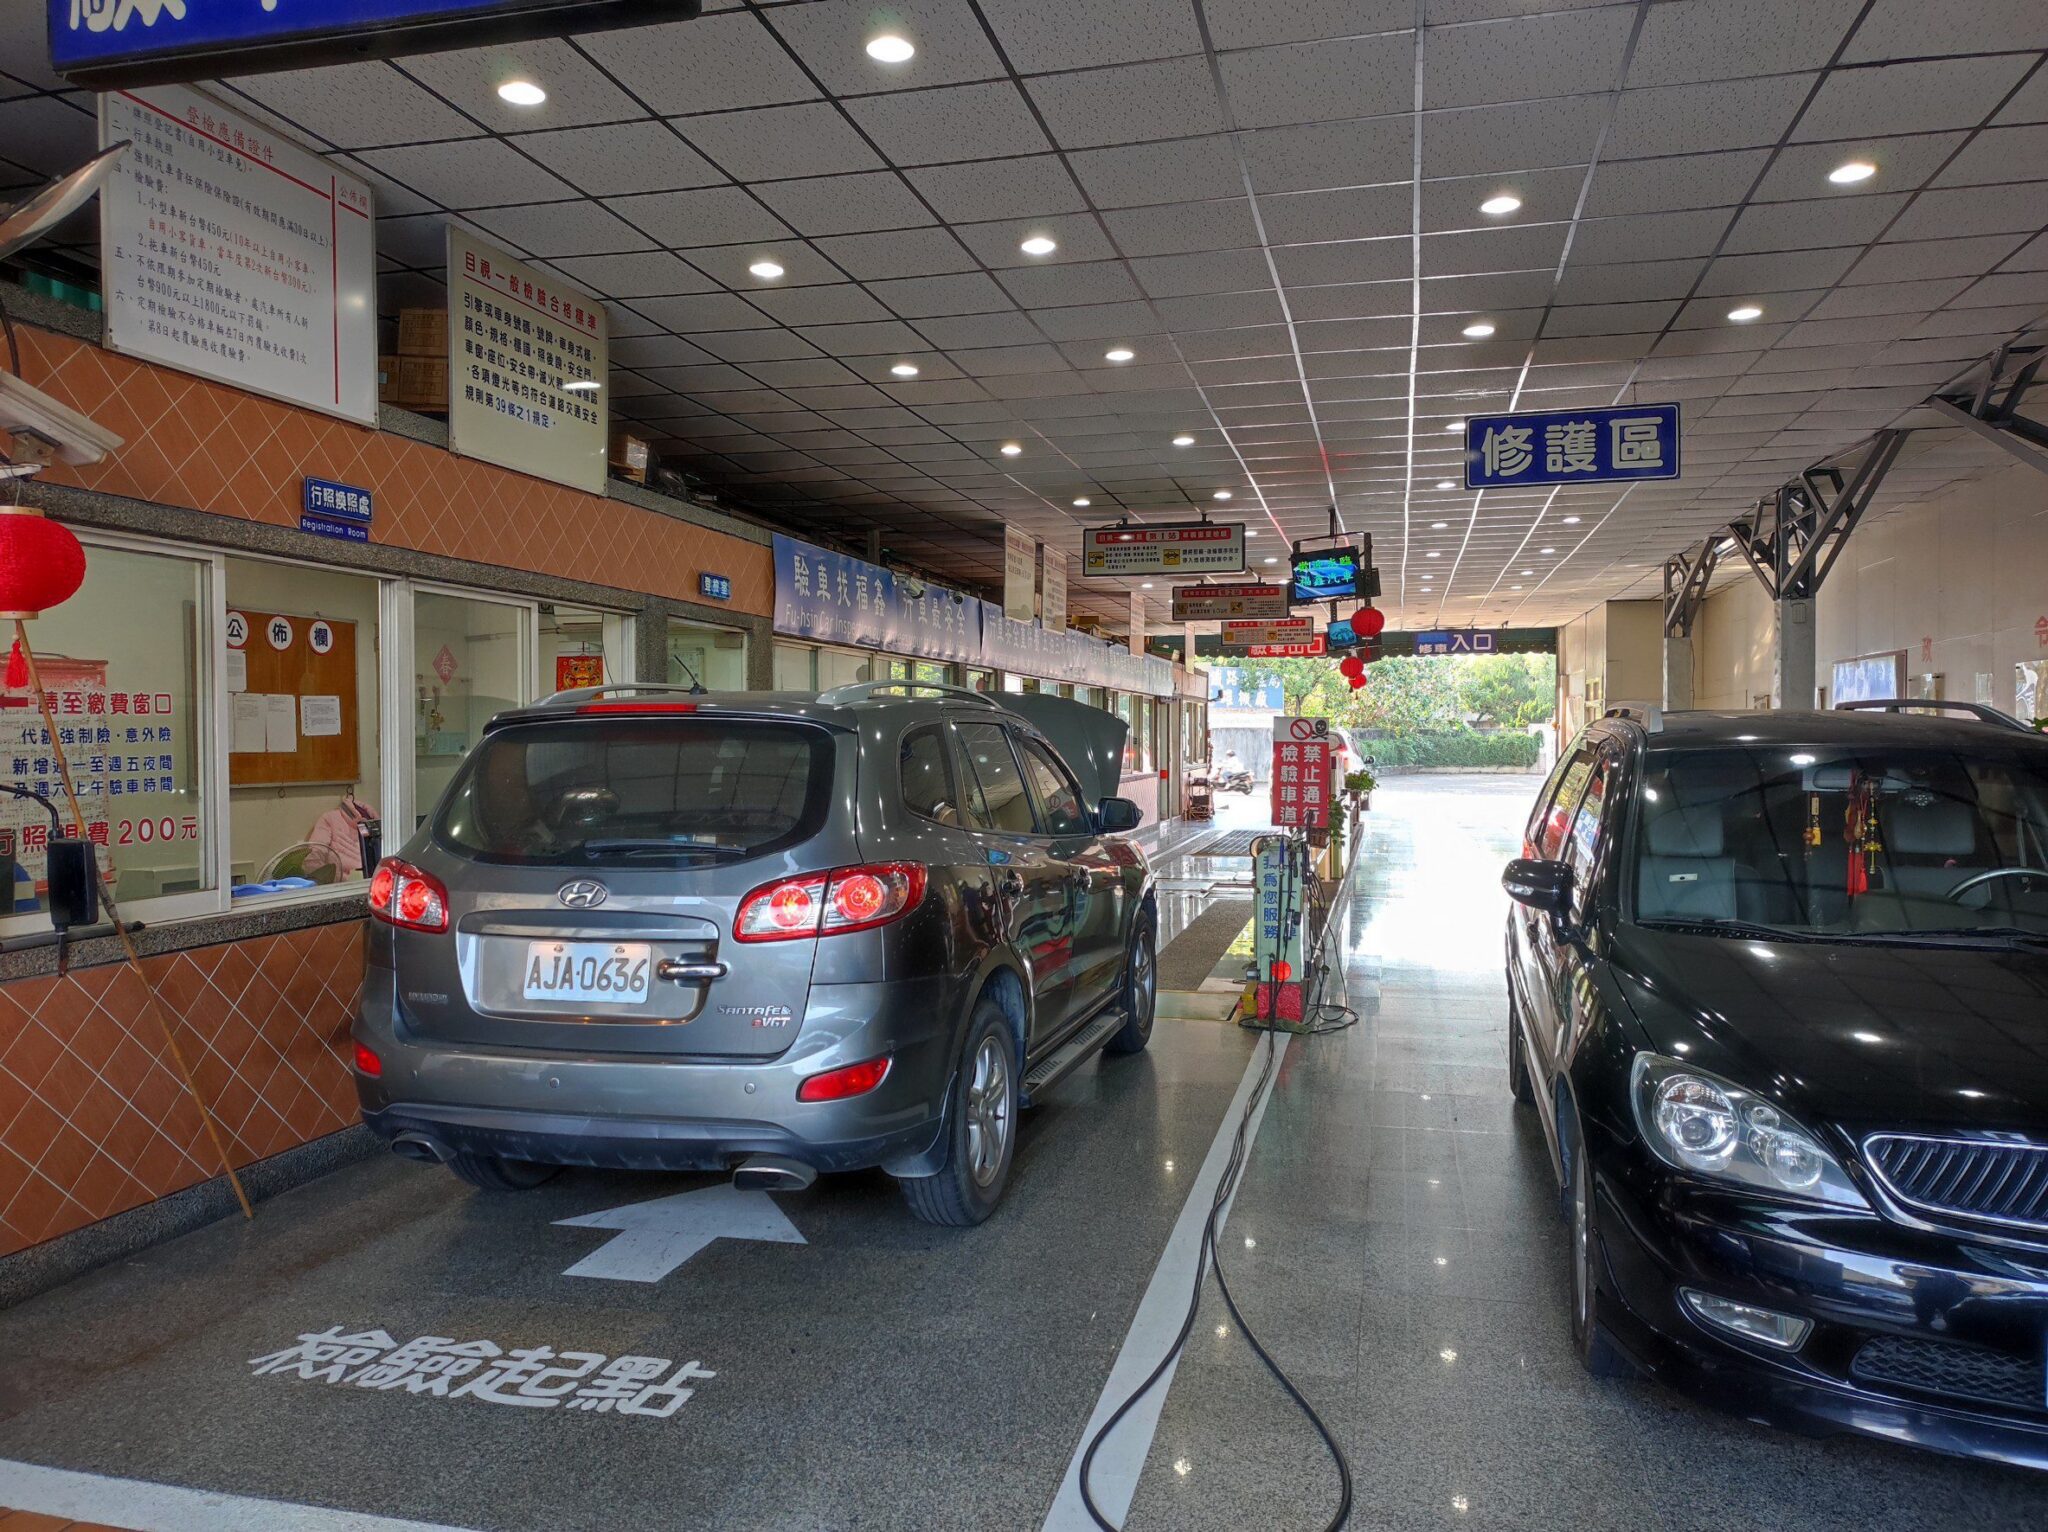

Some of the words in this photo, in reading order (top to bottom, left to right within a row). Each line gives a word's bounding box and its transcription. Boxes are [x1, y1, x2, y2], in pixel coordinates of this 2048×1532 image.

[465, 252, 598, 333] 目視一般檢驗合格標準
[1481, 415, 1664, 478] 修護區
[302, 519, 343, 535] Registration
[348, 527, 366, 538] Room
[311, 485, 370, 515] 行照換照處
[228, 617, 328, 647] 公佈欄
[38, 692, 173, 716] 請至繳費窗口
[1280, 743, 1299, 824] 檢驗車道
[1302, 744, 1322, 825] 禁止通行
[247, 1325, 717, 1418] 檢驗起點
